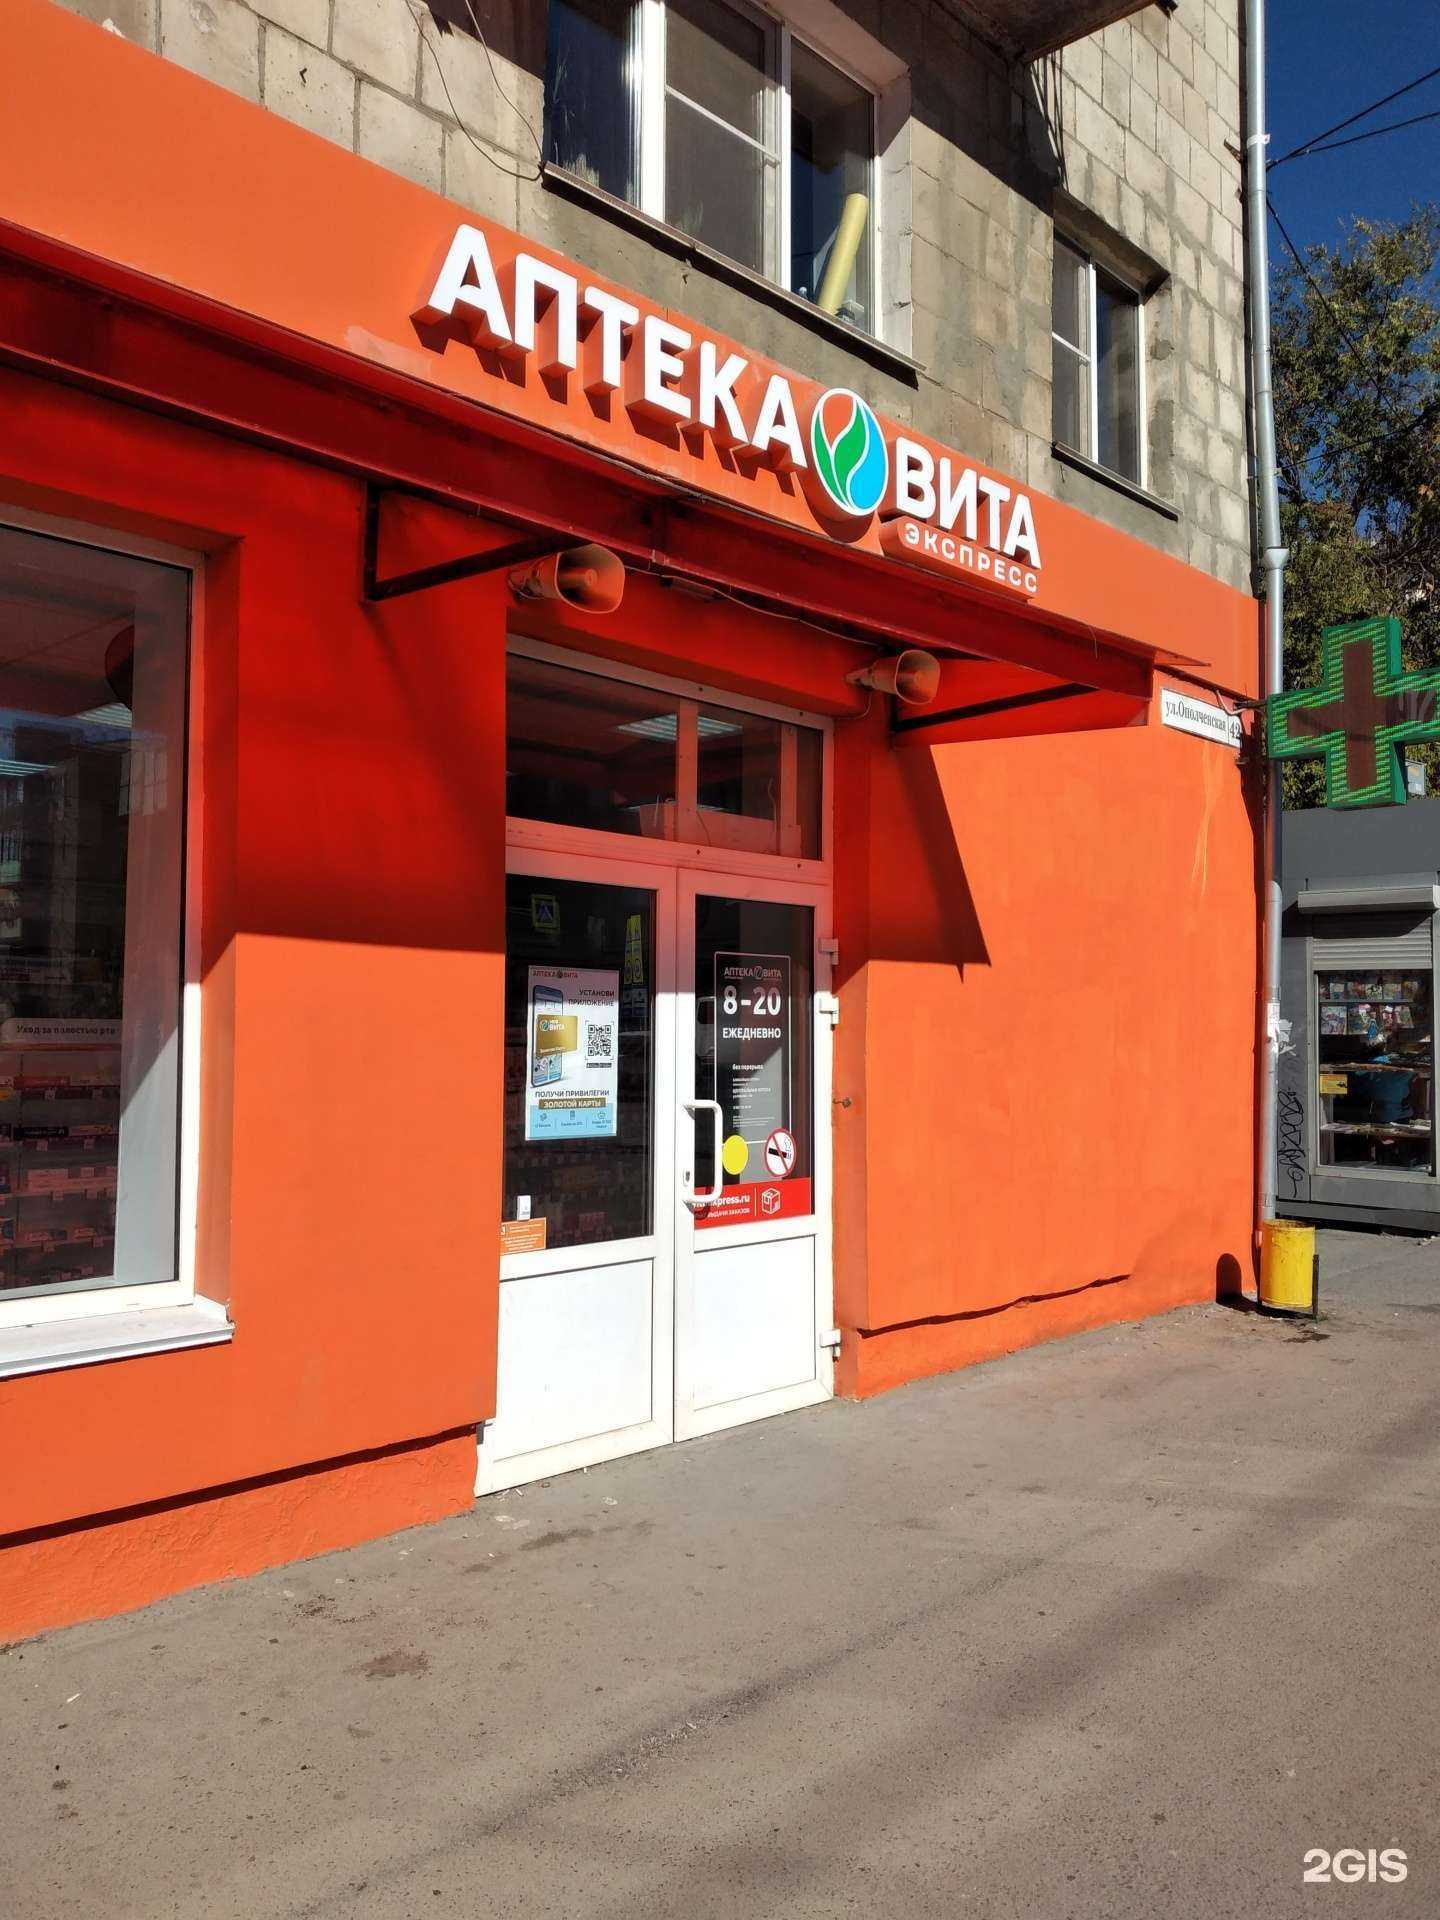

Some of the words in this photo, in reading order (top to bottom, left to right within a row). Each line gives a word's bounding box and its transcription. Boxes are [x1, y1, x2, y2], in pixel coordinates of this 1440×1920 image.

[428, 223, 808, 469] АПТЕКА
[896, 437, 1042, 570] ВИТА
[905, 523, 1038, 593] ЭКСПРЕСС
[724, 966, 754, 977] АПТЕКА
[763, 968, 782, 978] ВИТА
[579, 989, 615, 997] УСТАНОВИ
[568, 998, 614, 1006] ПРИЛОЖЕНИЕ
[722, 1027, 781, 1041] ЕЖЕДНЕВНО
[535, 1090, 564, 1098] ПОЛУЧИ
[565, 1089, 609, 1097] ПРИВИЛЕГИИ
[543, 1100, 577, 1108] ЗОЛОТОЙ
